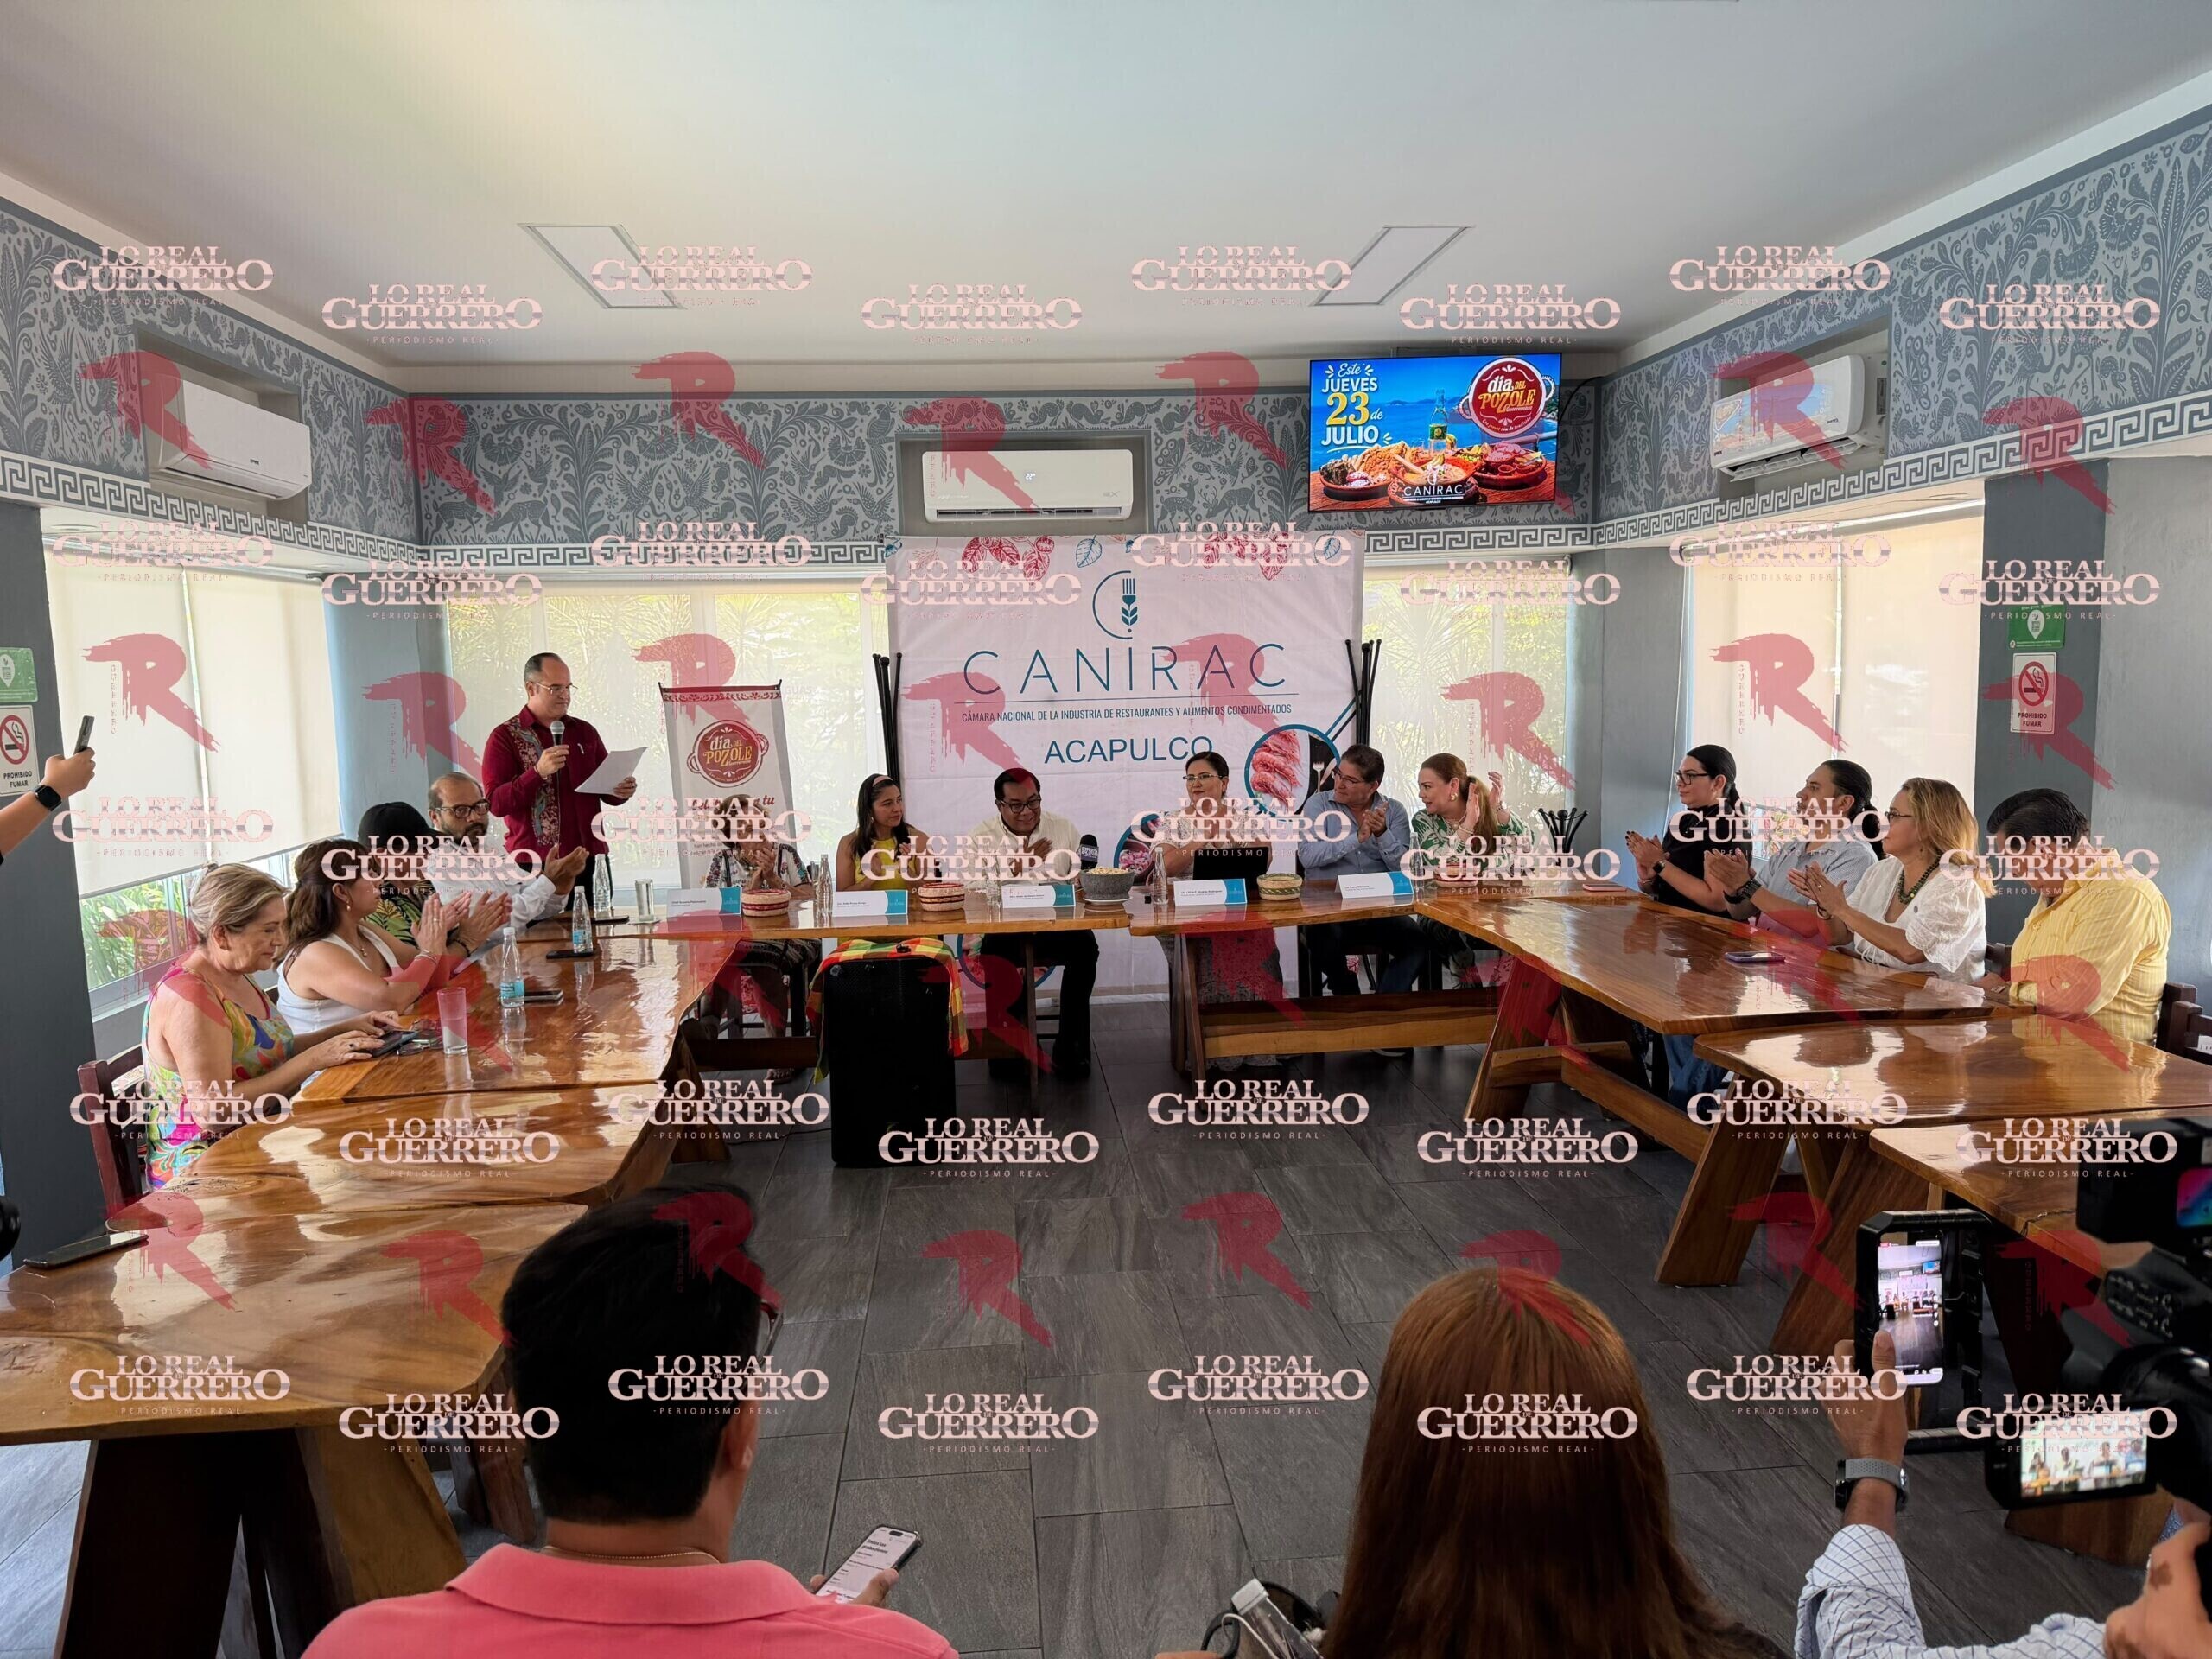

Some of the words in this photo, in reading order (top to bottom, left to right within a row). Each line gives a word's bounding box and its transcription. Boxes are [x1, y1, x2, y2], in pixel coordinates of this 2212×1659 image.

[1338, 363, 1361, 377] Este
[1322, 378, 1377, 392] JUEVES
[1515, 380, 1526, 390] DEL
[1326, 391, 1370, 425] 23
[1370, 408, 1383, 420] de
[1478, 389, 1536, 413] POZOLE
[1321, 425, 1379, 445] JULIO
[1403, 485, 1464, 497] CANIRAC
[963, 643, 1286, 695] CANIRAC
[962, 709, 995, 723] CÁMARA
[997, 711, 1035, 721] NACIONAL
[1038, 710, 1047, 721] DE
[1050, 710, 1059, 721] LA
[1061, 709, 1102, 720] INDUSTRIA
[1104, 709, 1114, 719] DE
[1116, 707, 1173, 718] RESTAURANTES
[1175, 707, 1181, 716] Y
[1183, 706, 1225, 716] ALIMENTOS
[1227, 704, 1292, 715] CONDIMENTADOS
[703, 746, 753, 767] POZOLE
[1044, 736, 1213, 764] ACAPULCO
[3, 771, 32, 779] PROHIBIDO
[763, 795, 774, 805] tu
